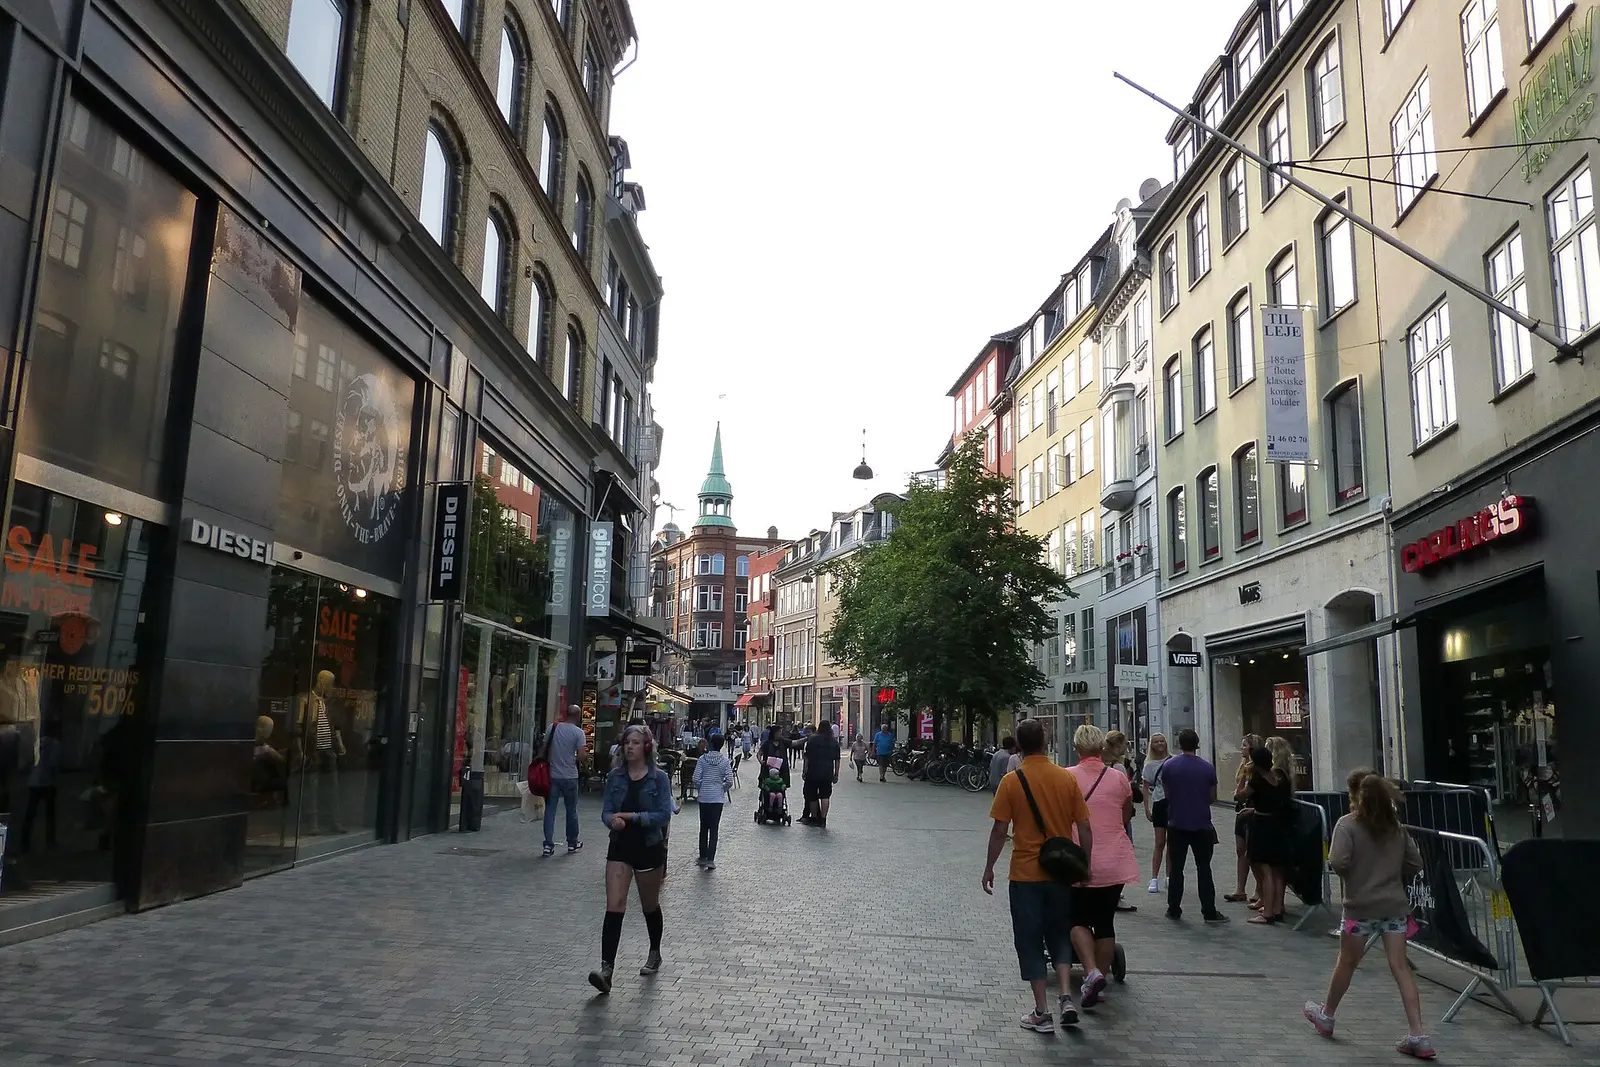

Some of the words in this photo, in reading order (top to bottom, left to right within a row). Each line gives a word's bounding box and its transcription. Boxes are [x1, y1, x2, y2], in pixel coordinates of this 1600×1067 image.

[1267, 313, 1294, 325] TIL
[1264, 325, 1302, 338] LEJE
[1269, 355, 1285, 365] 185
[1273, 366, 1296, 376] flotte
[1266, 376, 1304, 387] klassiske
[1269, 387, 1301, 397] kontor-
[1271, 398, 1301, 408] lokaler
[1278, 435, 1287, 443] 46
[190, 518, 277, 566] DIESEL
[439, 495, 459, 588] DIESEL
[4, 525, 98, 587] SALE
[592, 528, 611, 609] ginatricot
[319, 605, 359, 641] SALE
[1172, 653, 1198, 665] VANS
[68, 666, 139, 685] REDUCTIONS
[63, 683, 76, 694] UP
[77, 685, 88, 695] TO
[88, 684, 135, 716] 50%
